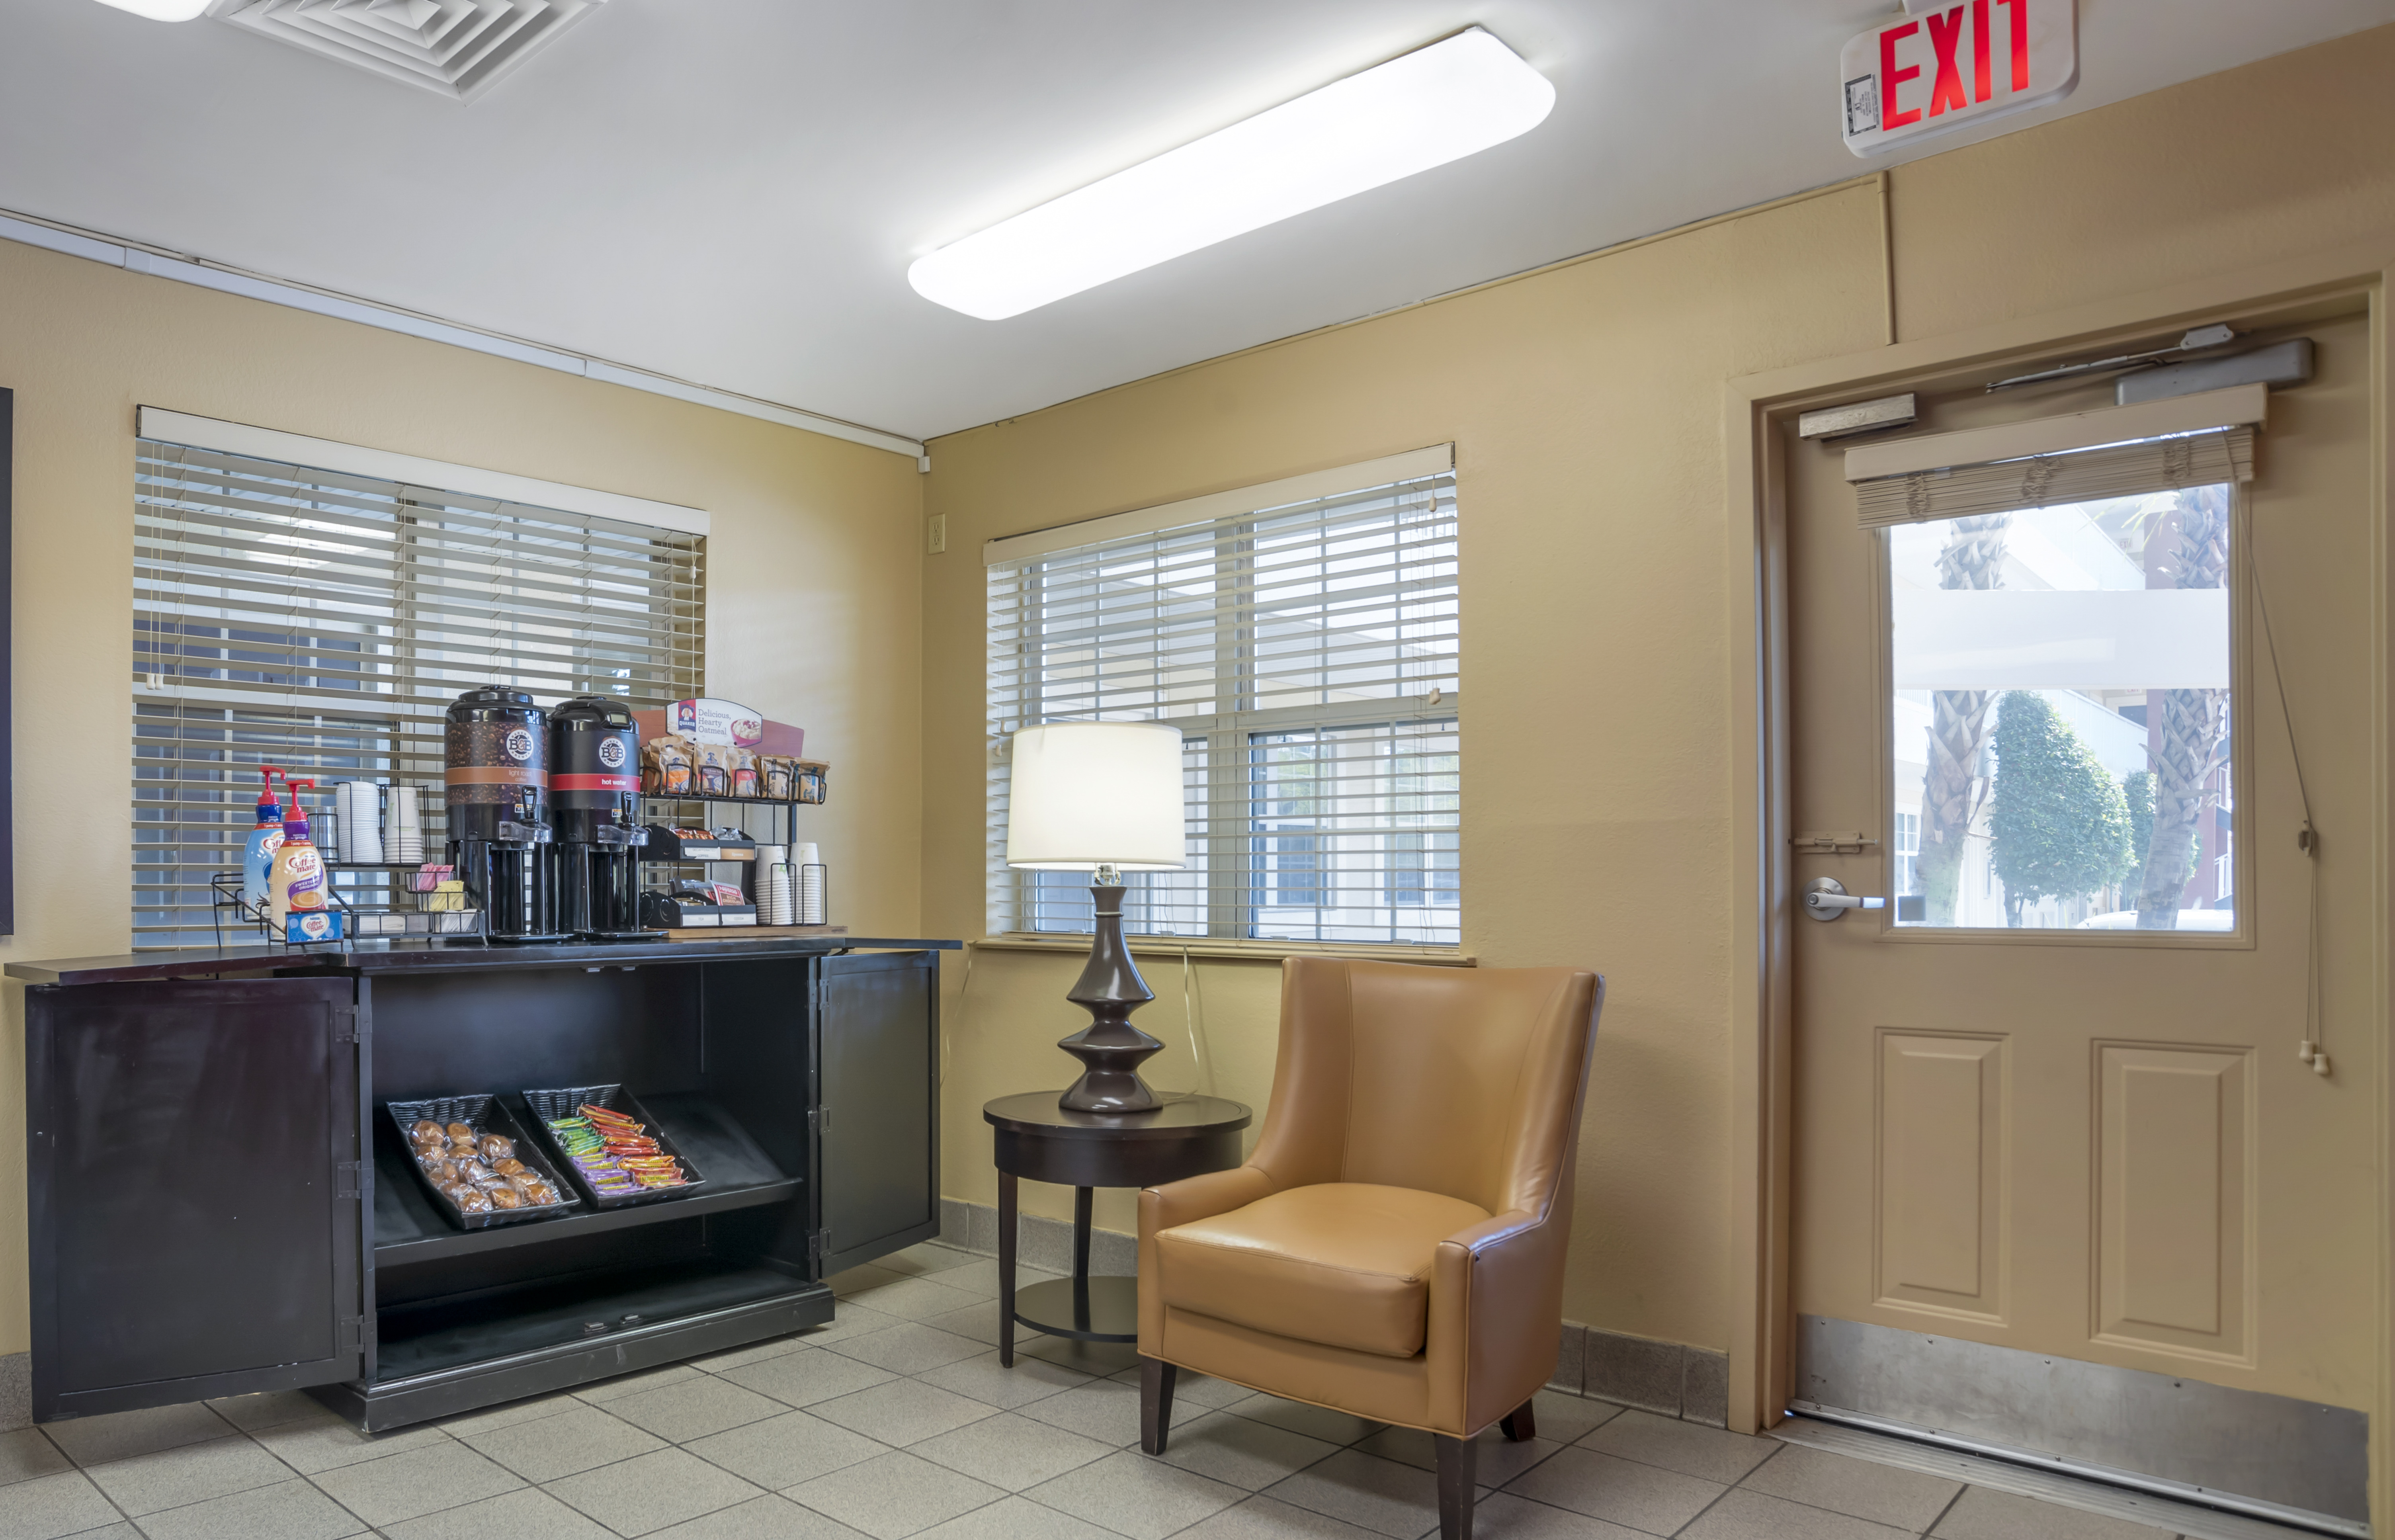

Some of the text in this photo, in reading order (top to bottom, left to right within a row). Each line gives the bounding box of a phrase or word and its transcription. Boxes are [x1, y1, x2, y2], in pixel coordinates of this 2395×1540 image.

[1880, 0, 2029, 131] EXIT
[698, 709, 731, 720] Delicious,
[698, 717, 722, 728] Hearty
[698, 725, 727, 735] Oatmeal
[509, 739, 532, 751] B&B
[601, 747, 624, 758] B&B
[263, 838, 281, 849] Coff
[289, 857, 316, 868] Coffee
[297, 864, 315, 873] mate
